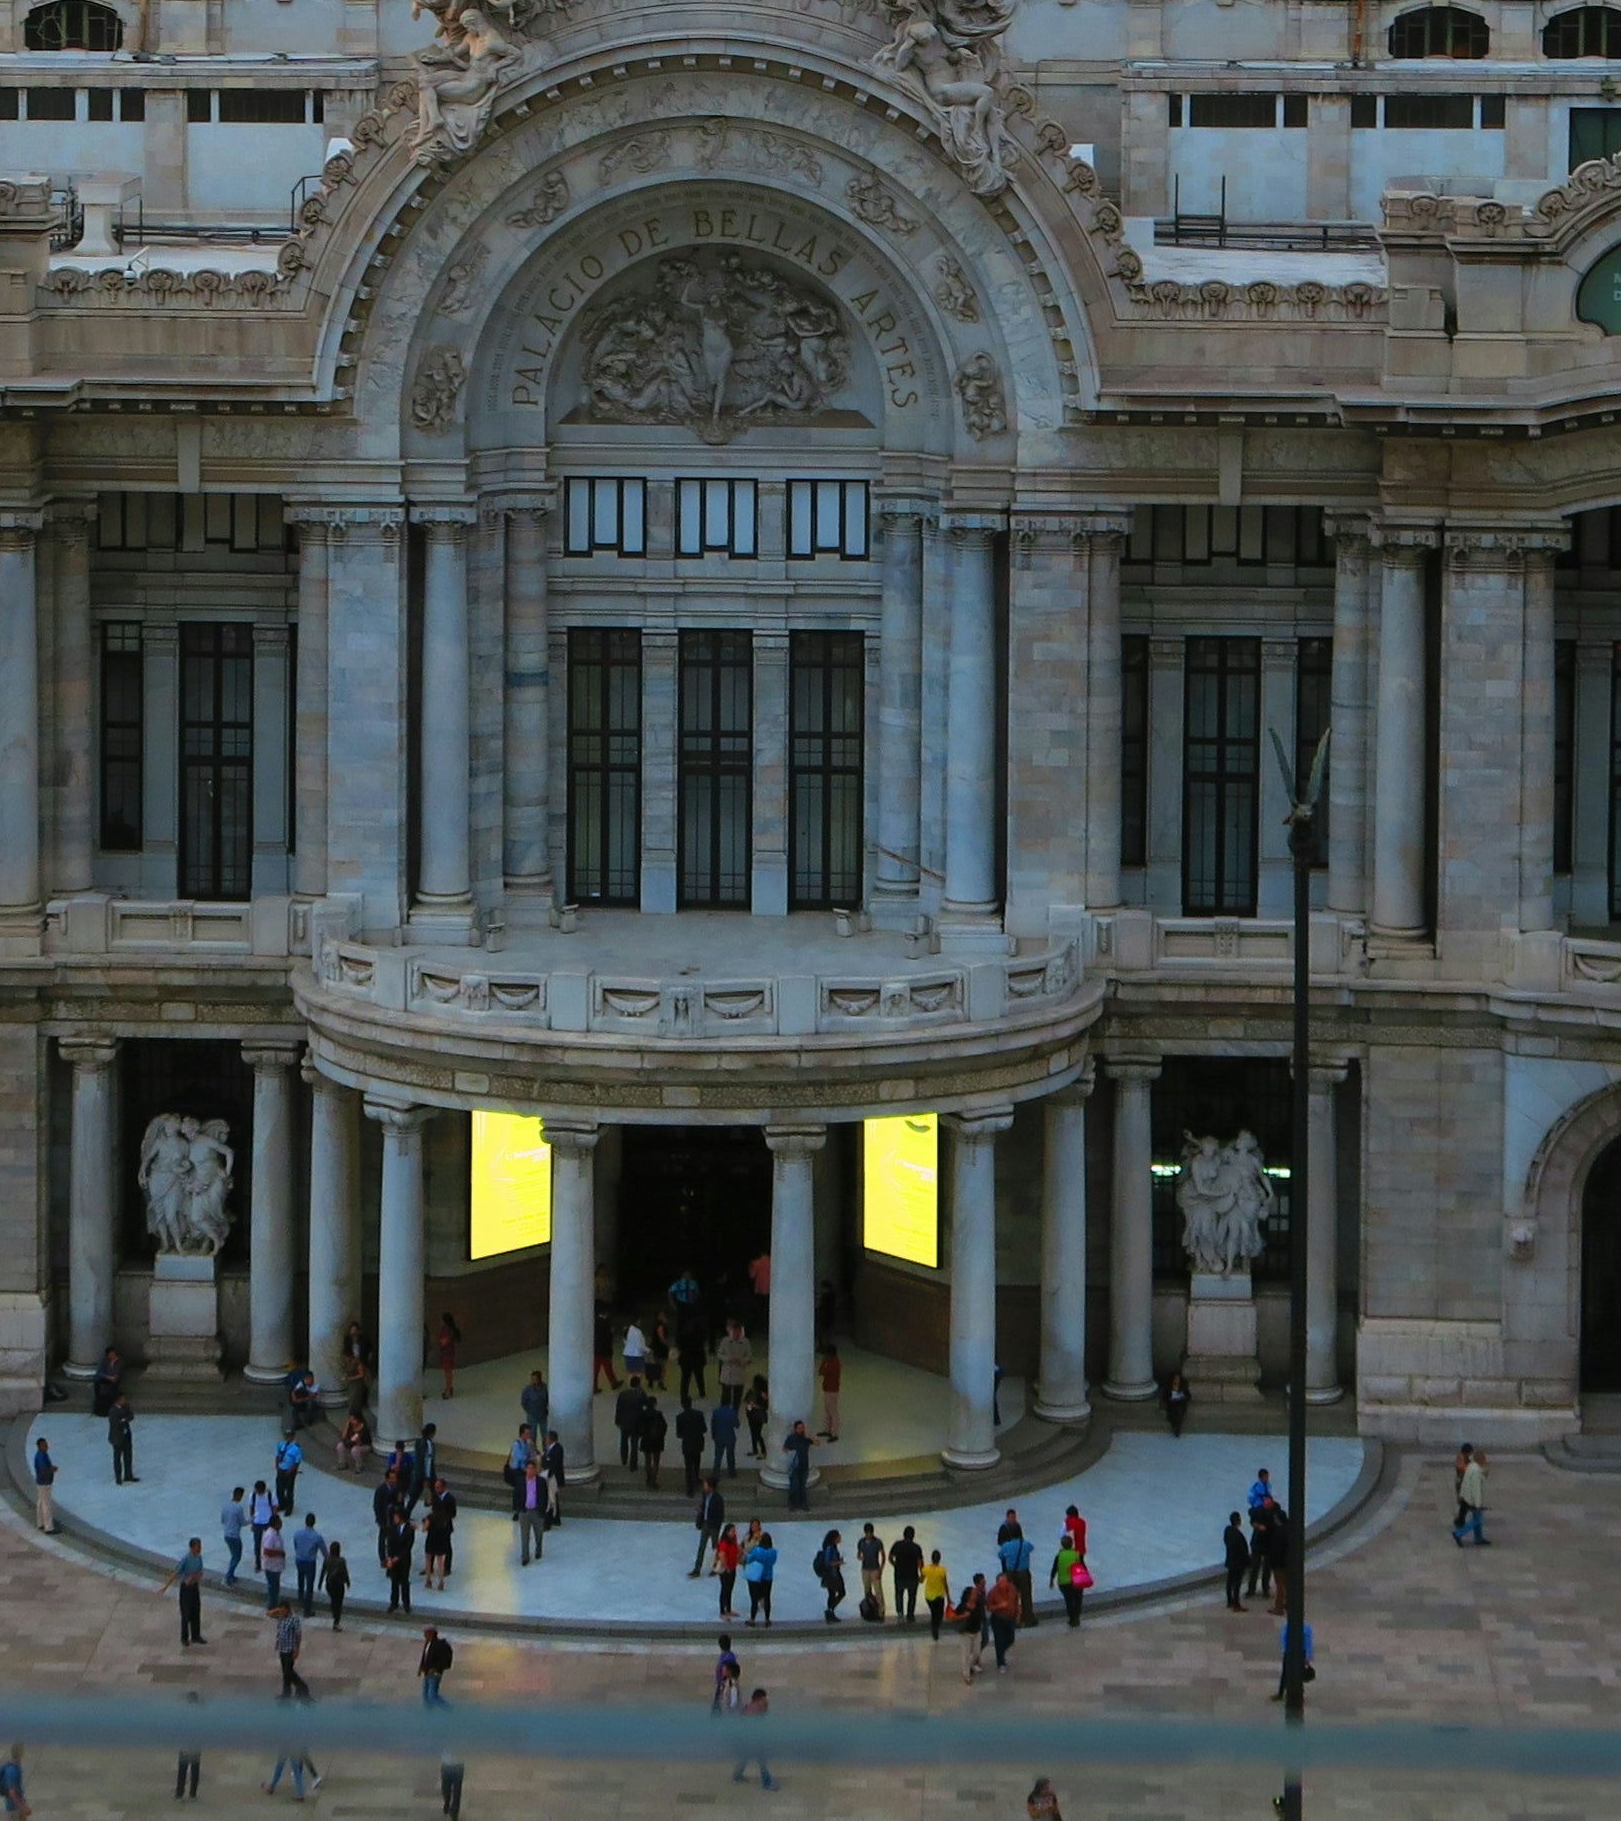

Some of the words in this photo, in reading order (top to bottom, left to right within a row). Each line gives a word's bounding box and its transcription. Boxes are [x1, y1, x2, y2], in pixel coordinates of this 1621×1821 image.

[511, 255, 604, 407] PALACIO
[617, 217, 669, 258] DE
[692, 209, 845, 276] BELLAS
[850, 289, 919, 409] ARTES
